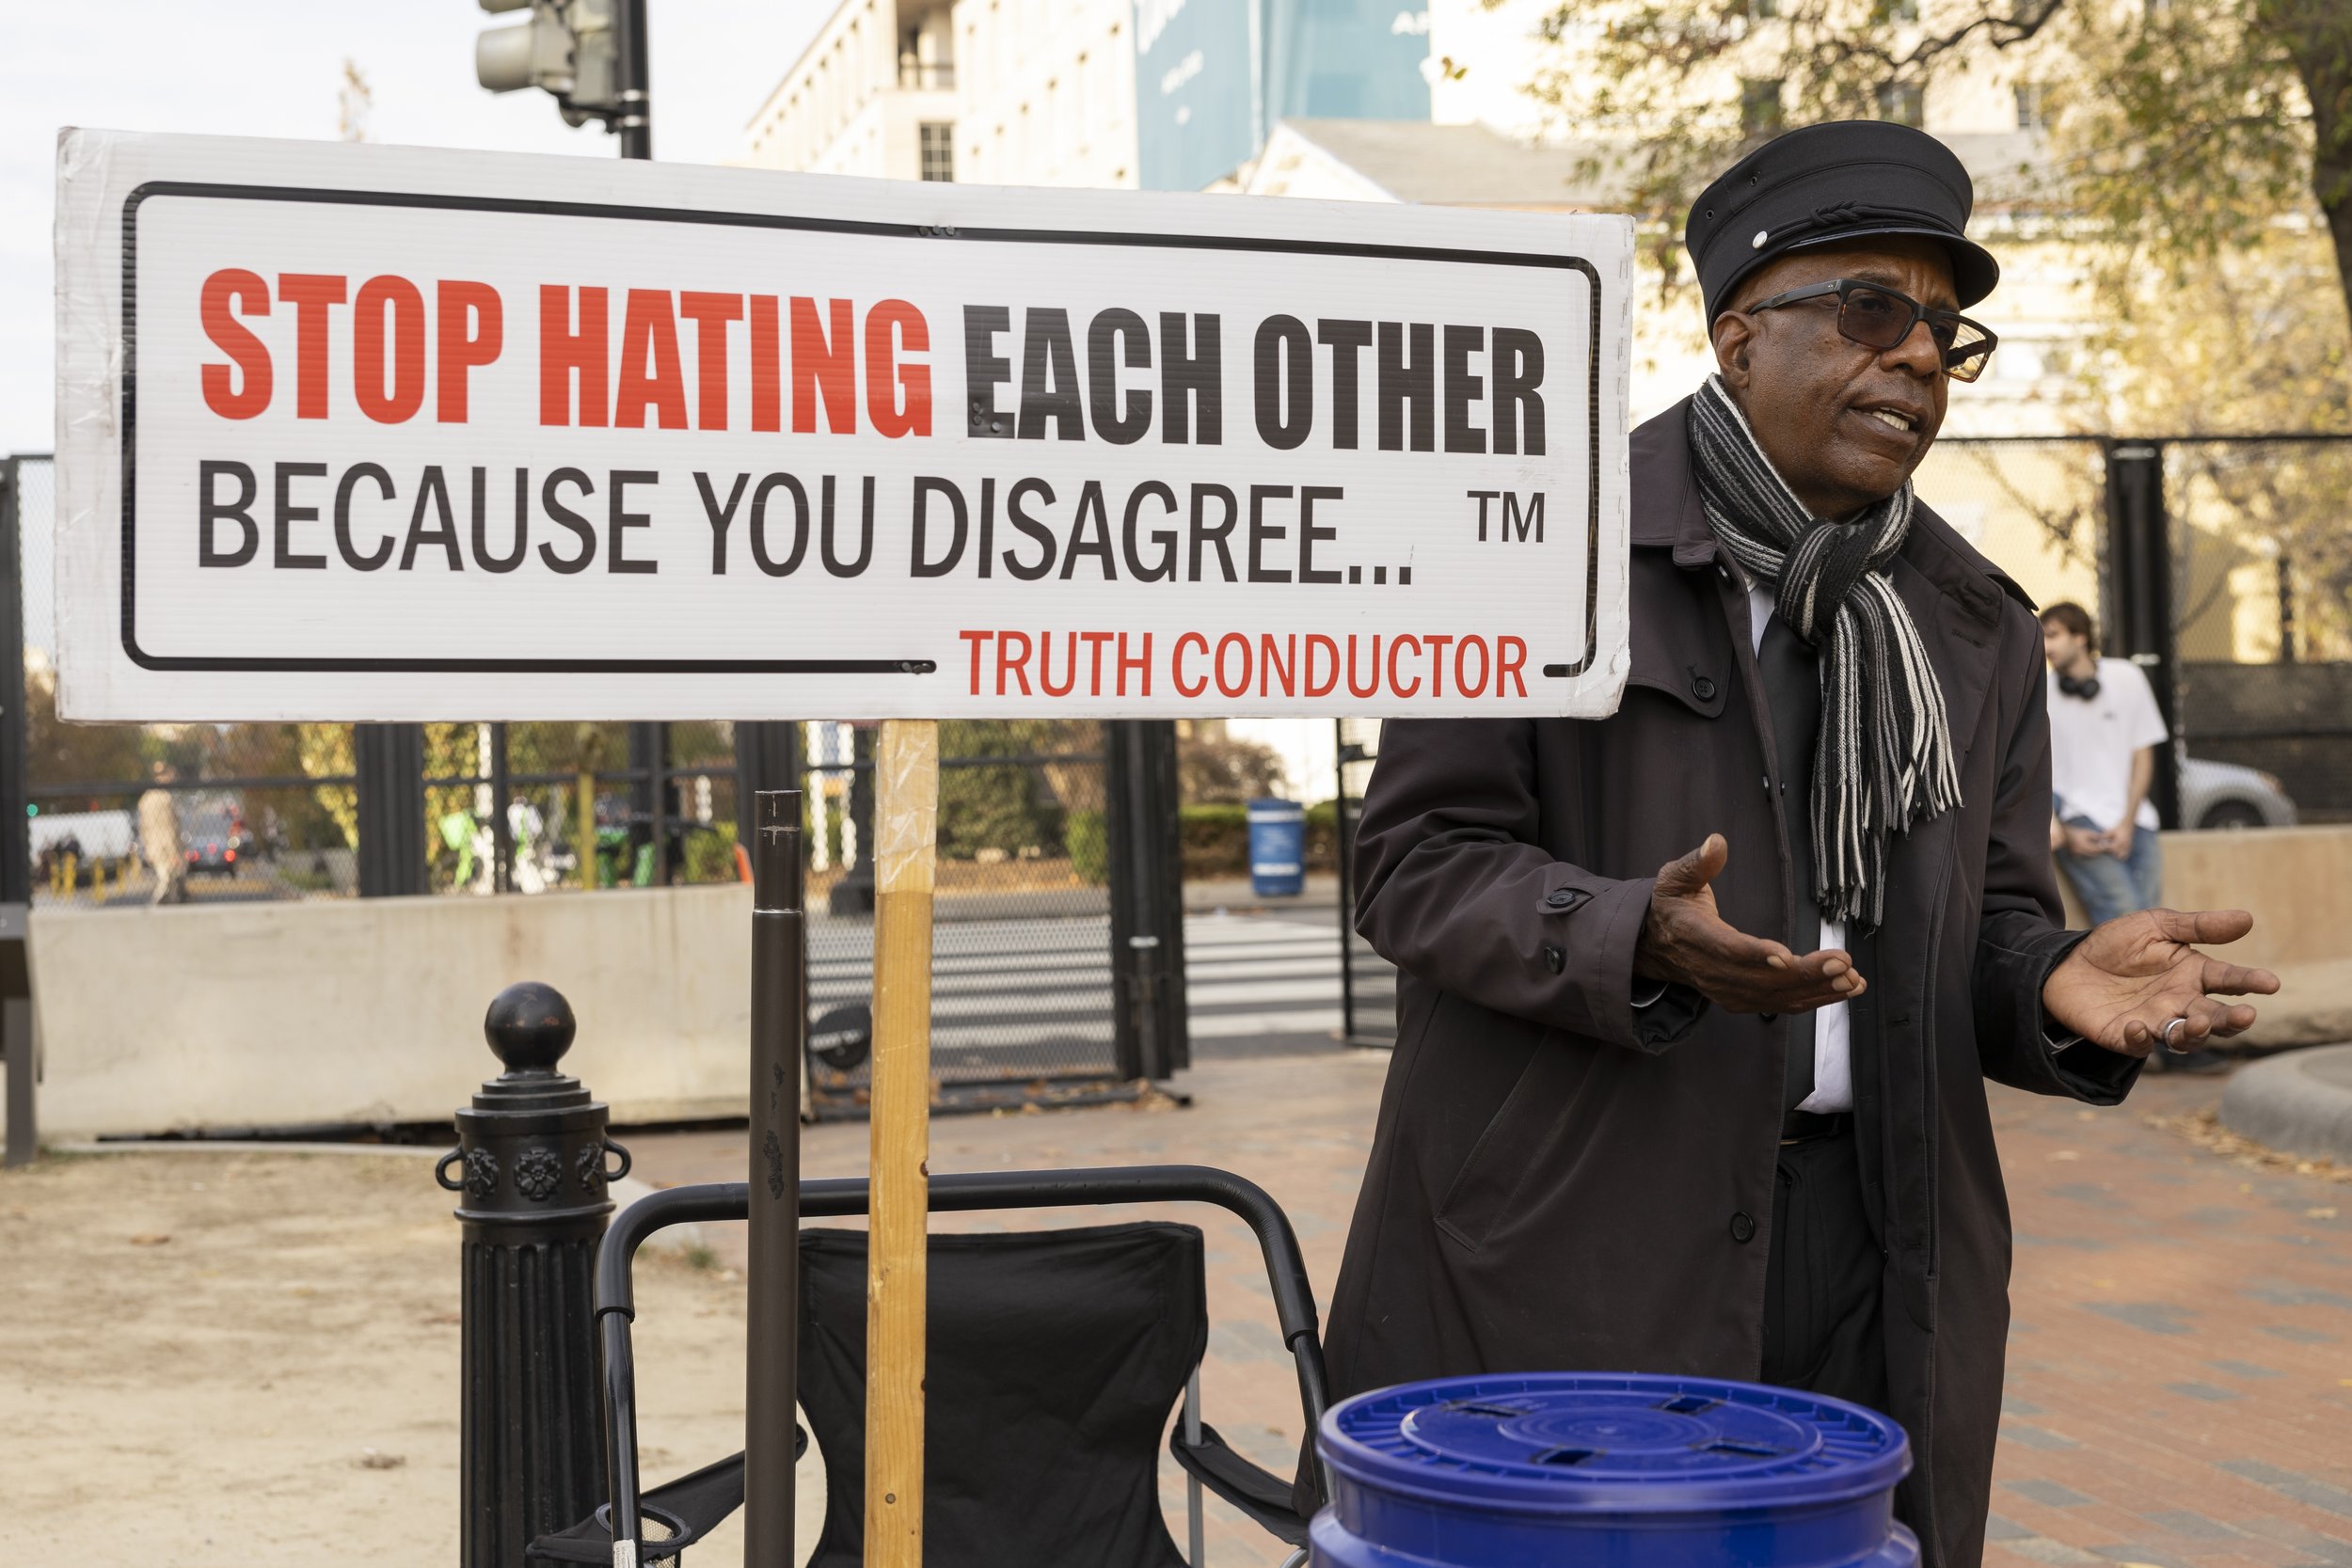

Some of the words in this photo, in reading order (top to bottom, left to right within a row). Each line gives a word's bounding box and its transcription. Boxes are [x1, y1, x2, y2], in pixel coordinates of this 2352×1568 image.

[200, 268, 503, 423] STOP
[539, 284, 932, 438] HATING
[963, 305, 1221, 446] EACH
[1254, 313, 1546, 456] OTHER
[199, 460, 659, 575] BECAUSE
[692, 471, 875, 578] YOU
[910, 476, 1412, 585] DISAGREE...
[1467, 490, 1545, 544] TM
[960, 630, 1152, 697] TRUTH
[1171, 631, 1528, 699] CONDUCTOR
